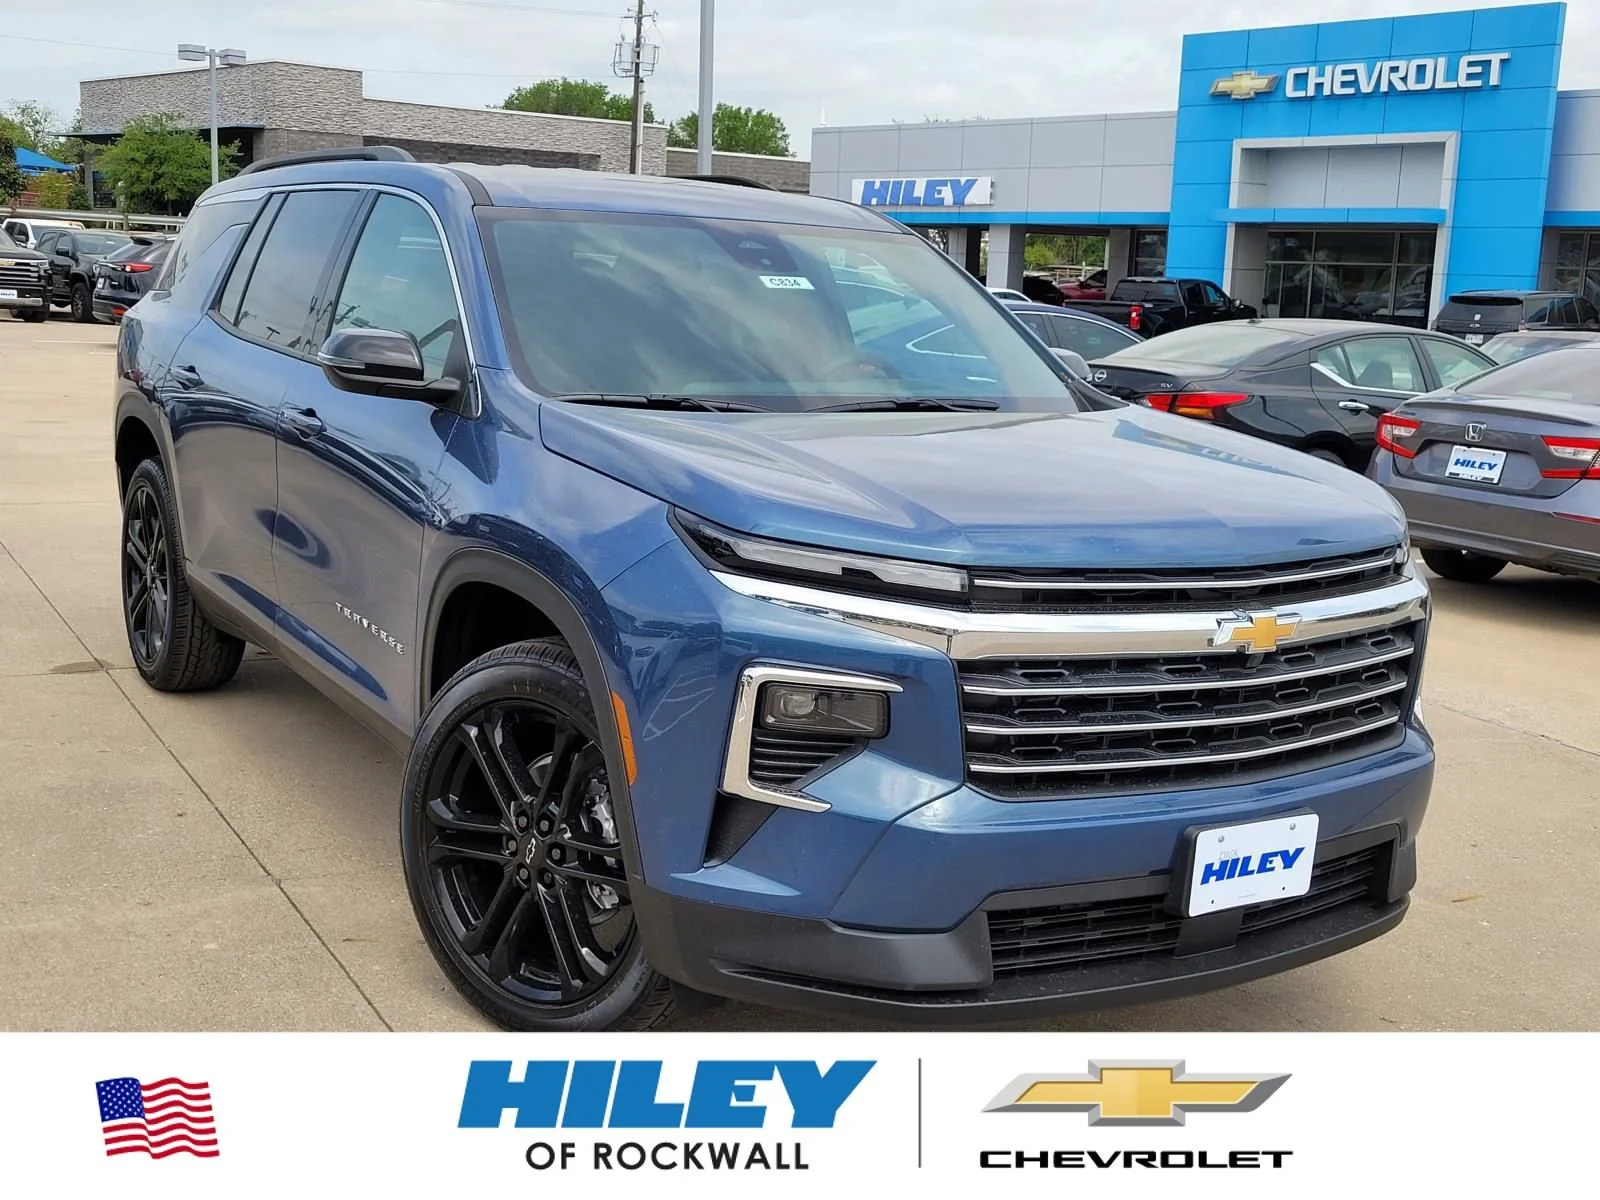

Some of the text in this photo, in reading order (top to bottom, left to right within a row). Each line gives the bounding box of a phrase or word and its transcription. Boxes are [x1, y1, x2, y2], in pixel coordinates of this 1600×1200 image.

[1285, 52, 1511, 98] CHEVROLET
[861, 178, 978, 206] HILEY
[769, 278, 801, 287] C834
[1453, 458, 1498, 471] HILEY
[335, 601, 405, 655] TRAVERSE
[1200, 846, 1305, 885] HILEY
